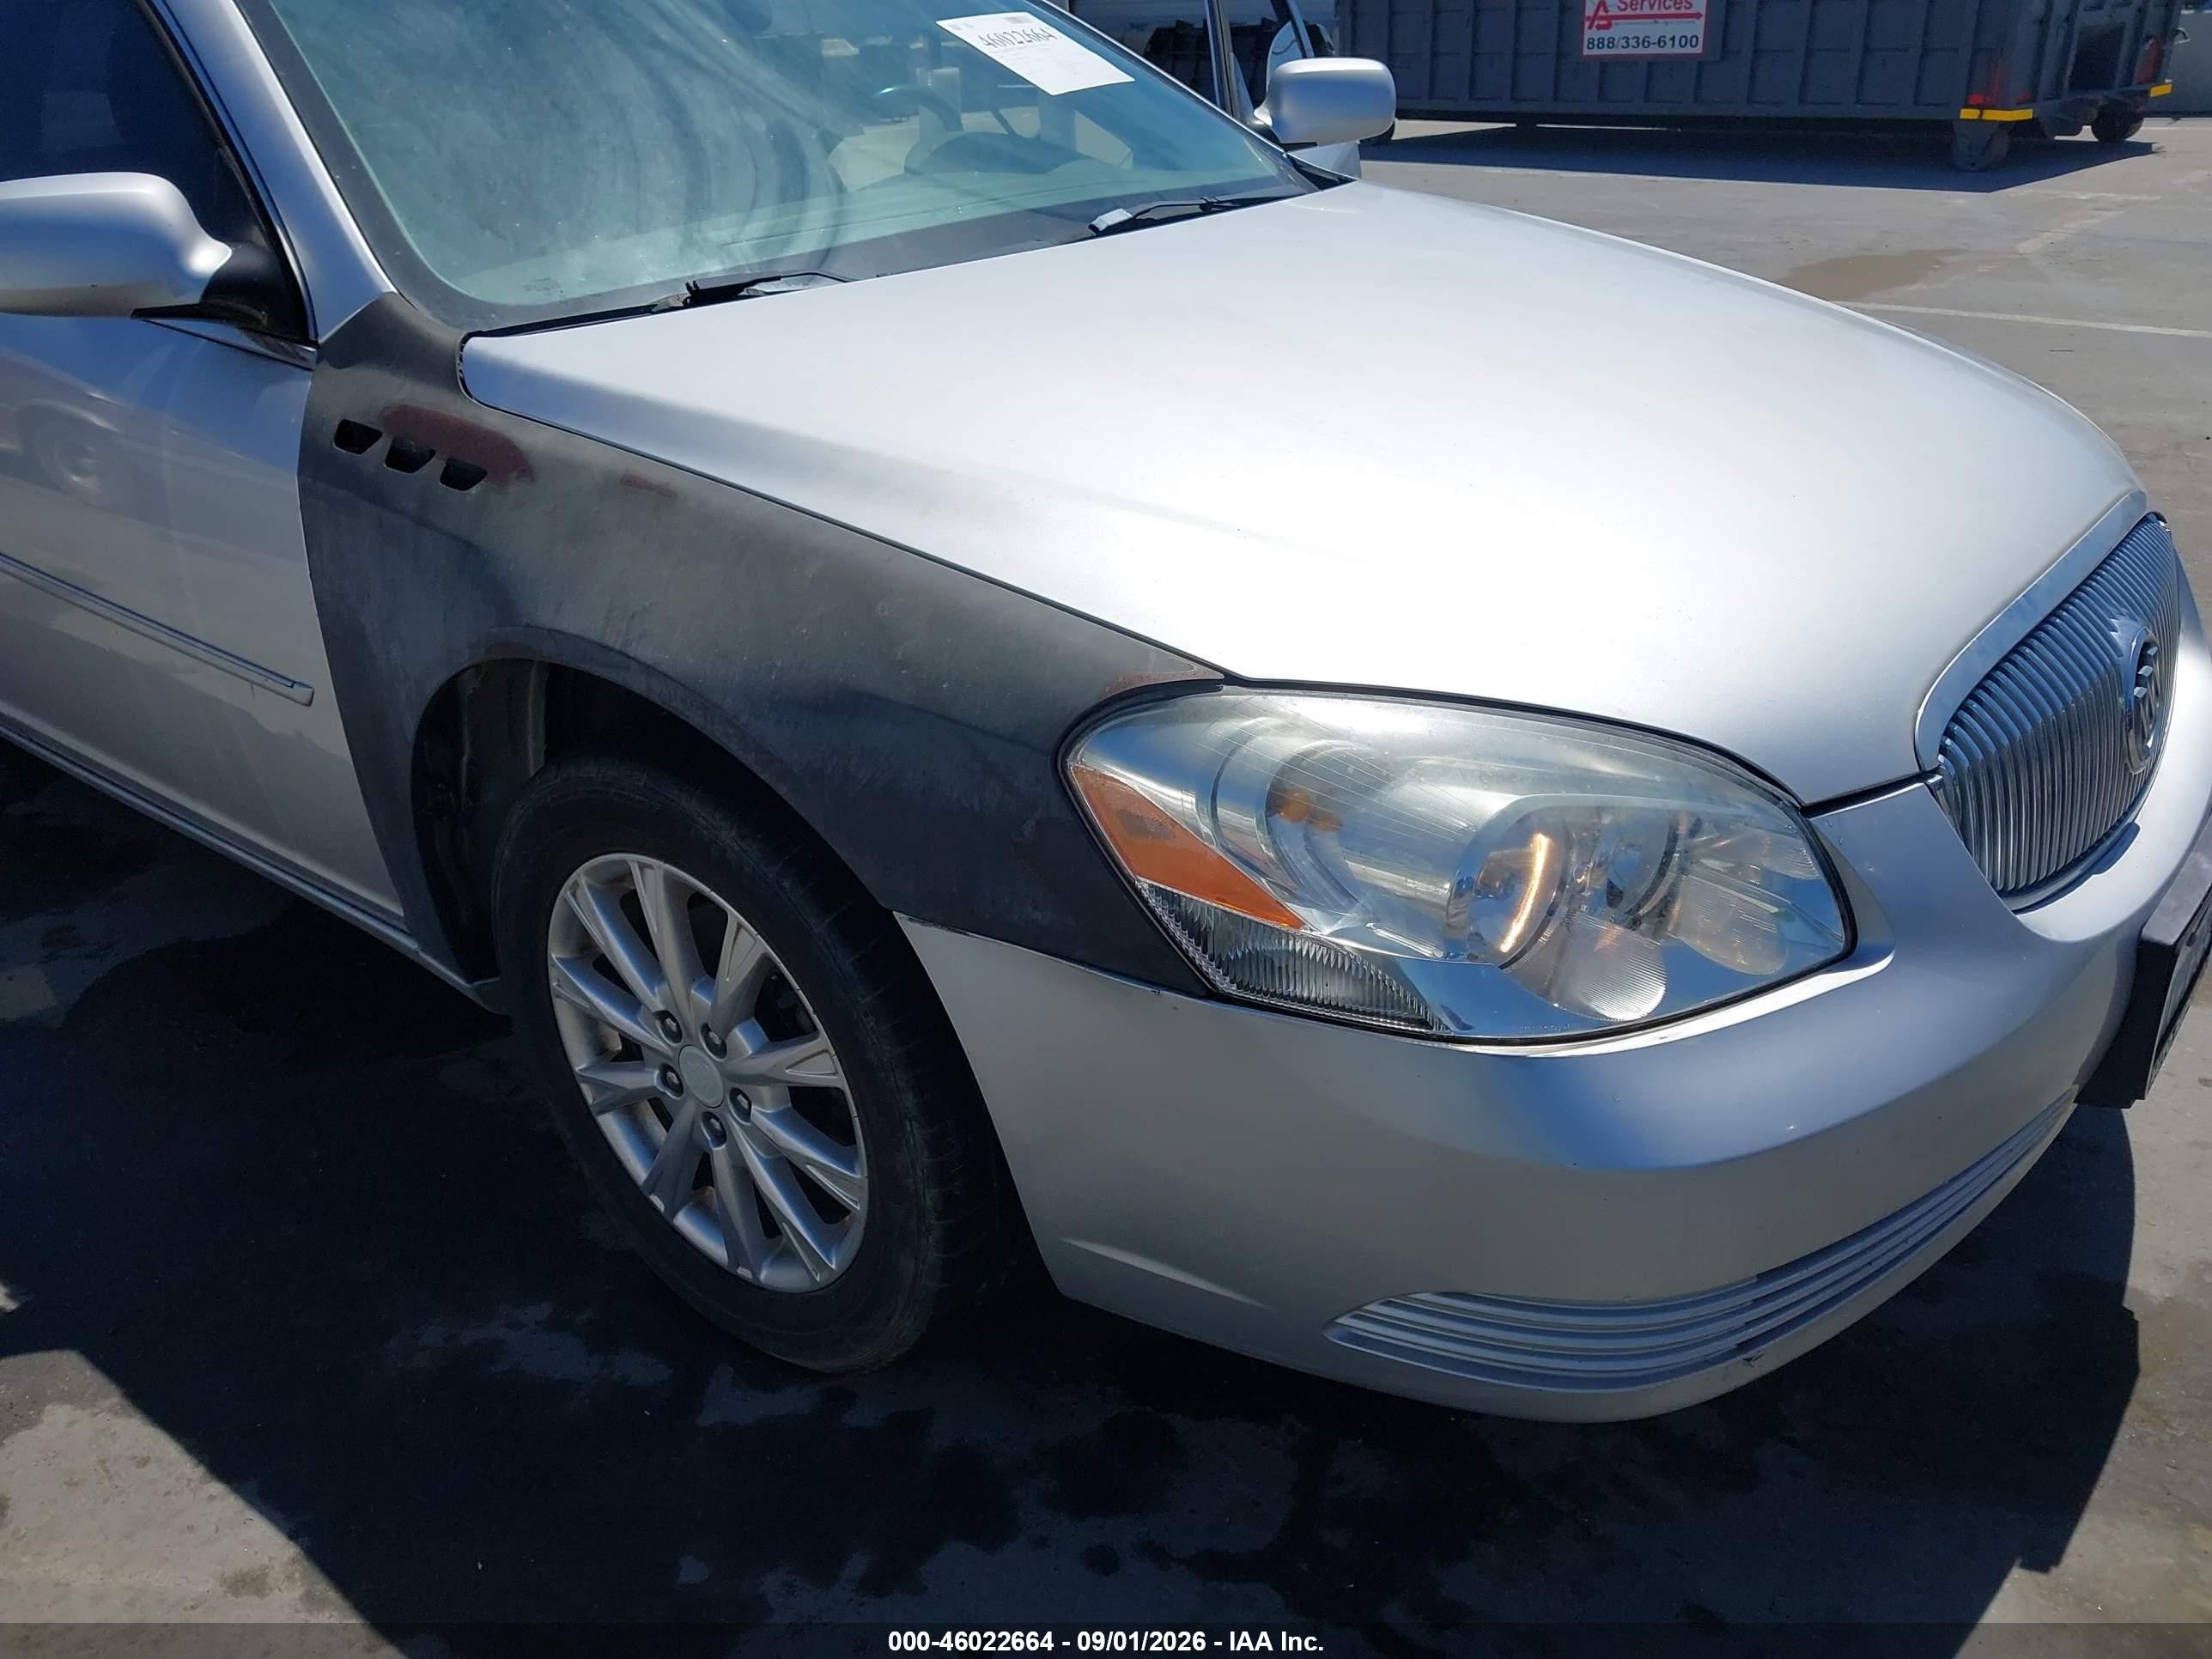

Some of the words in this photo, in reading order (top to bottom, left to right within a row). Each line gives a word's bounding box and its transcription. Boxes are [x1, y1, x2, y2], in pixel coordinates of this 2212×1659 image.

[1617, 0, 1693, 11] Services
[978, 28, 1058, 48] 46022664
[1586, 34, 1699, 50] 888/336-6100
